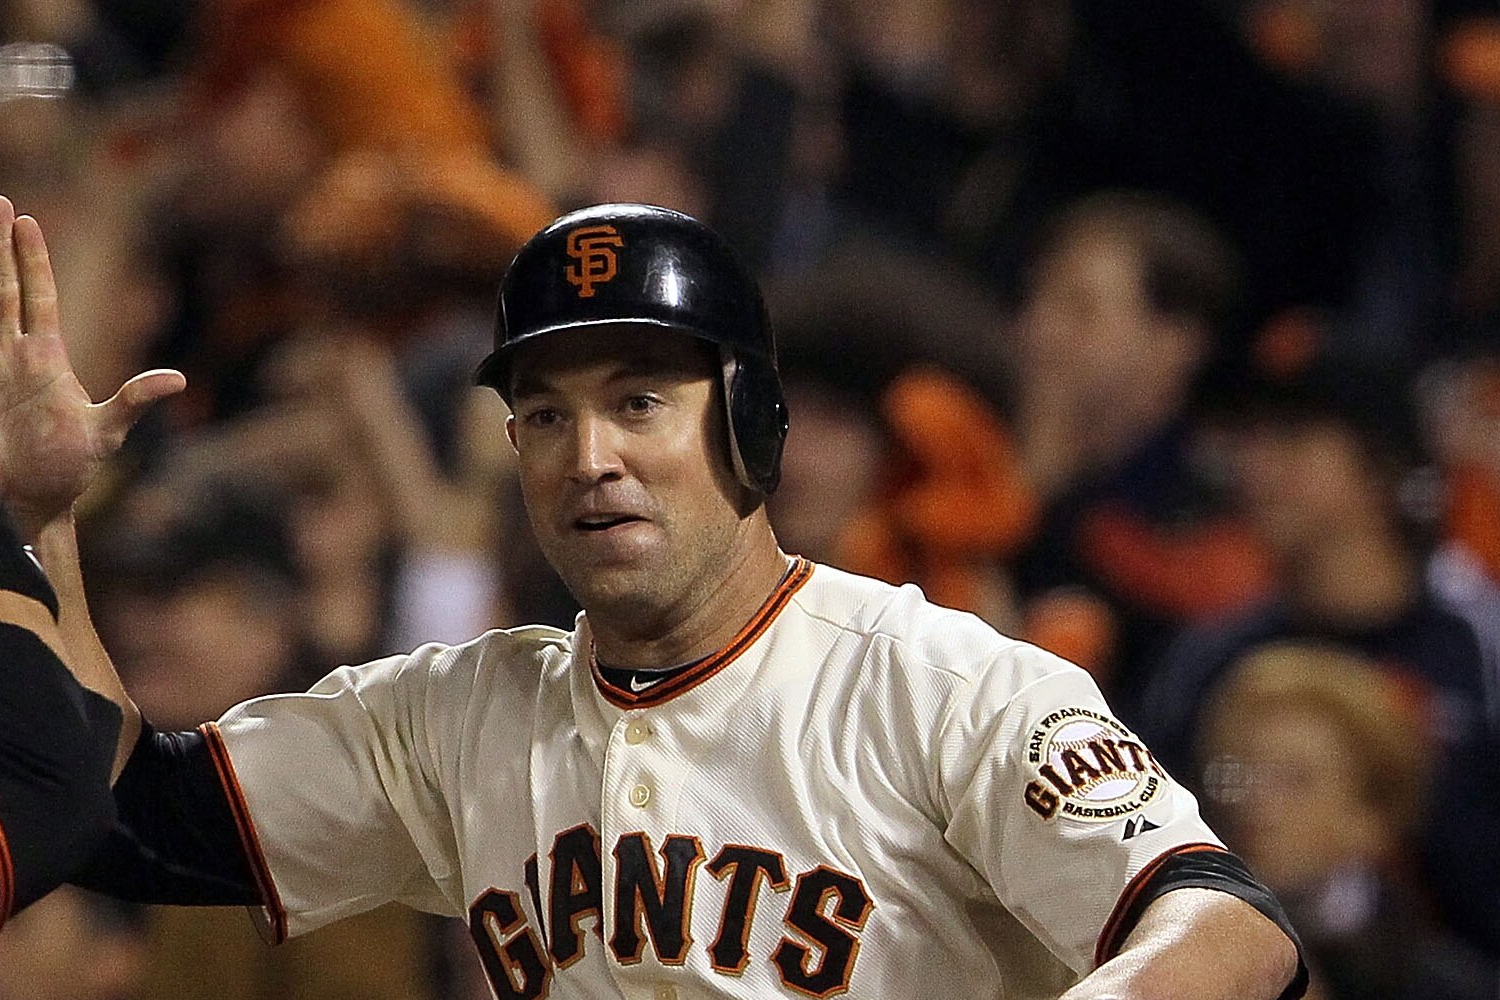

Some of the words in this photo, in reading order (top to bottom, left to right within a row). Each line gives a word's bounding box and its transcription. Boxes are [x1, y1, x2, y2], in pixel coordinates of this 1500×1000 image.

[565, 225, 625, 298] SF
[1029, 730, 1046, 763] SAN
[1041, 707, 1130, 738] FRANCISCO
[1062, 801, 1143, 819] BASEBALL
[1140, 776, 1160, 803] CLUB
